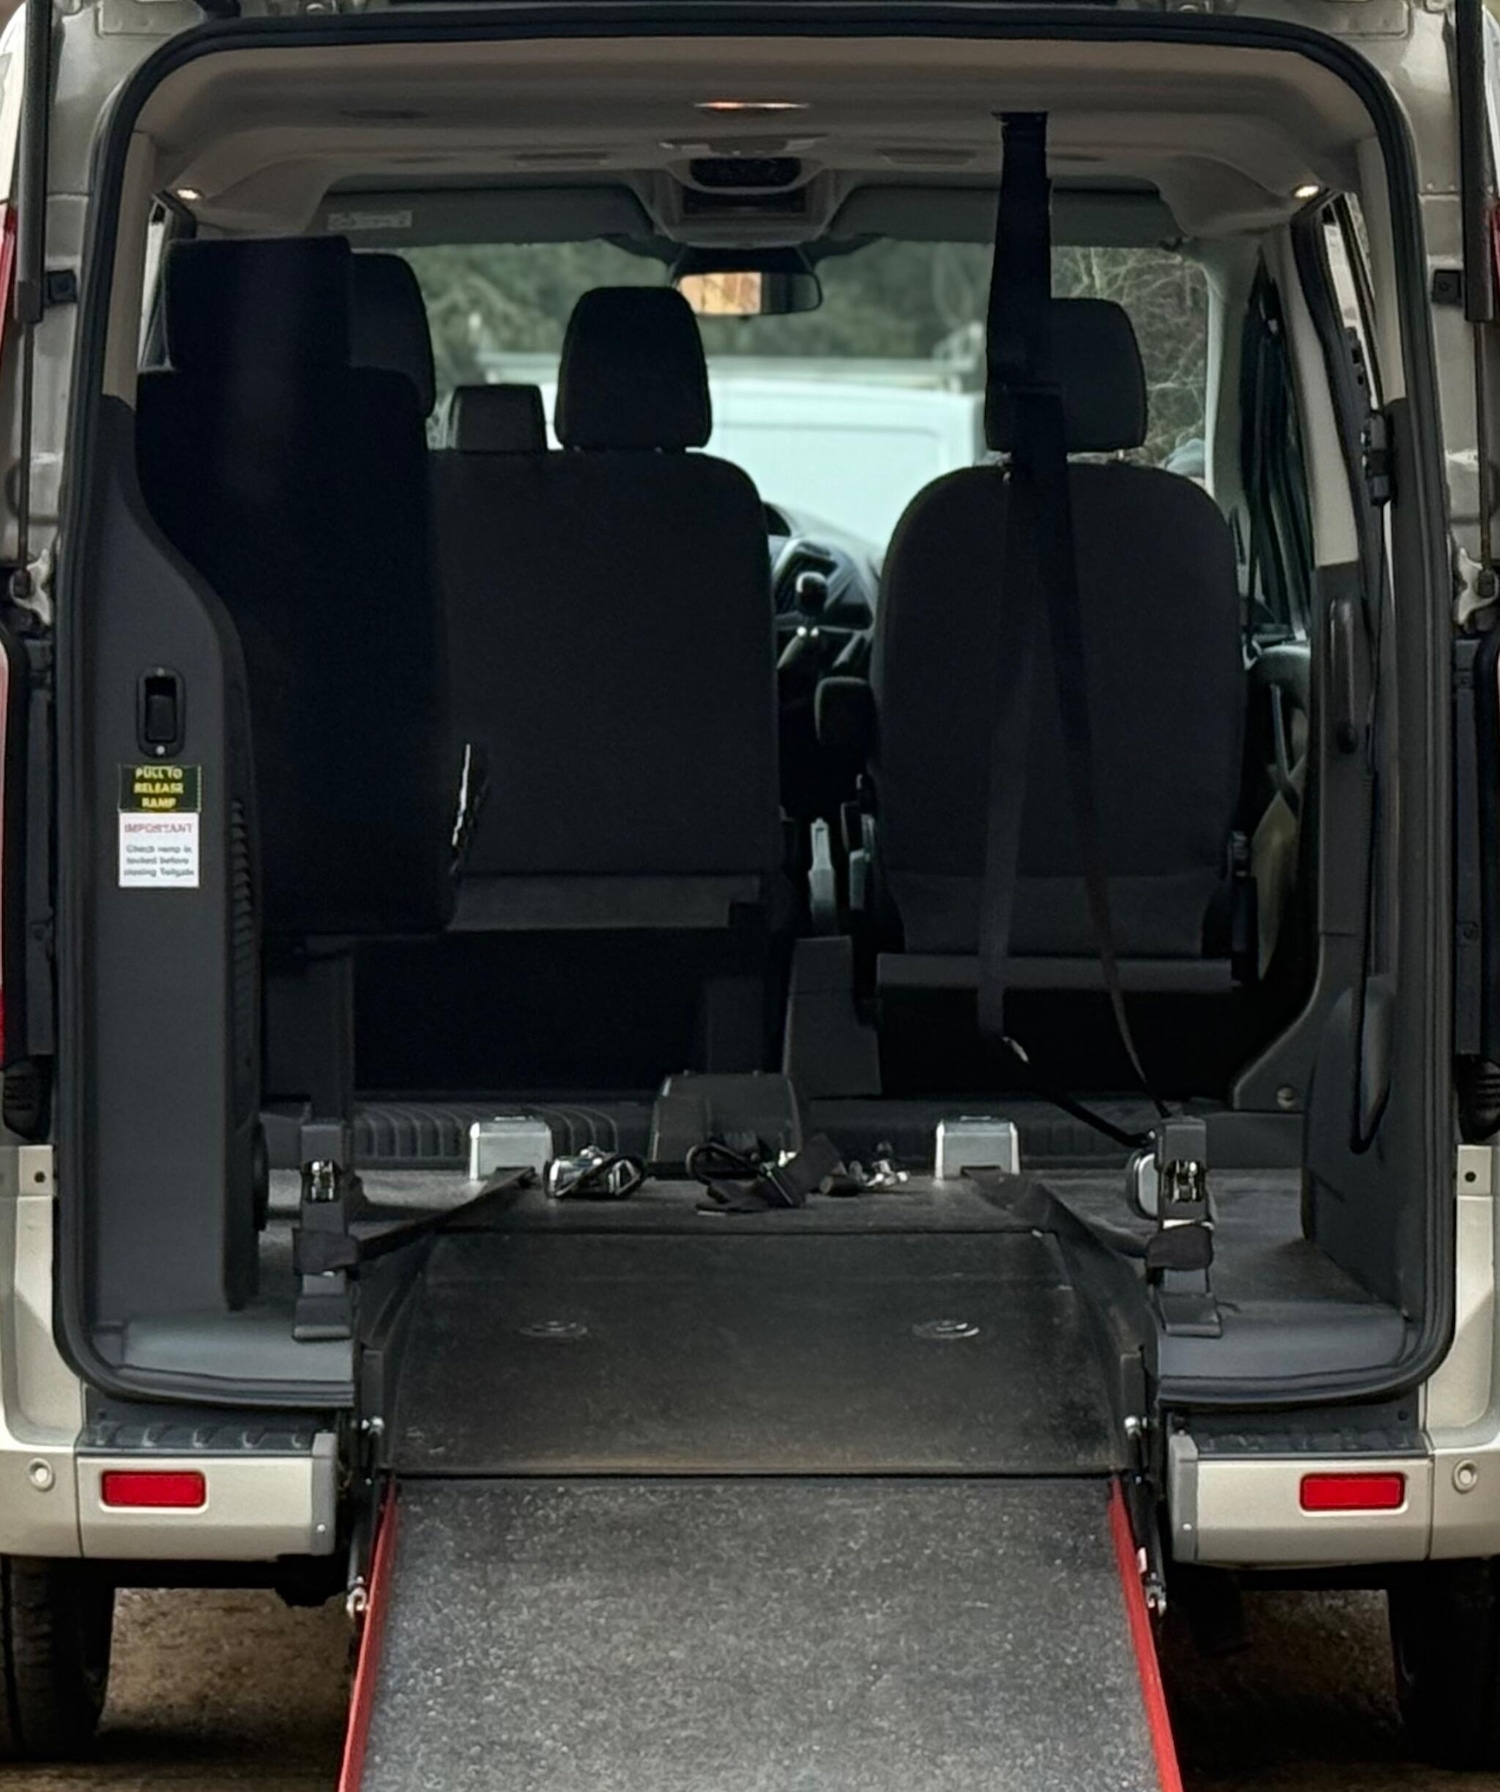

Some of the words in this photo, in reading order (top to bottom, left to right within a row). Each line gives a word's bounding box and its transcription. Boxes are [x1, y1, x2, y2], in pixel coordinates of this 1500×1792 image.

[134, 783, 184, 793] RELEASE
[142, 798, 177, 808] RAMP
[124, 823, 192, 833] IMPORTANT
